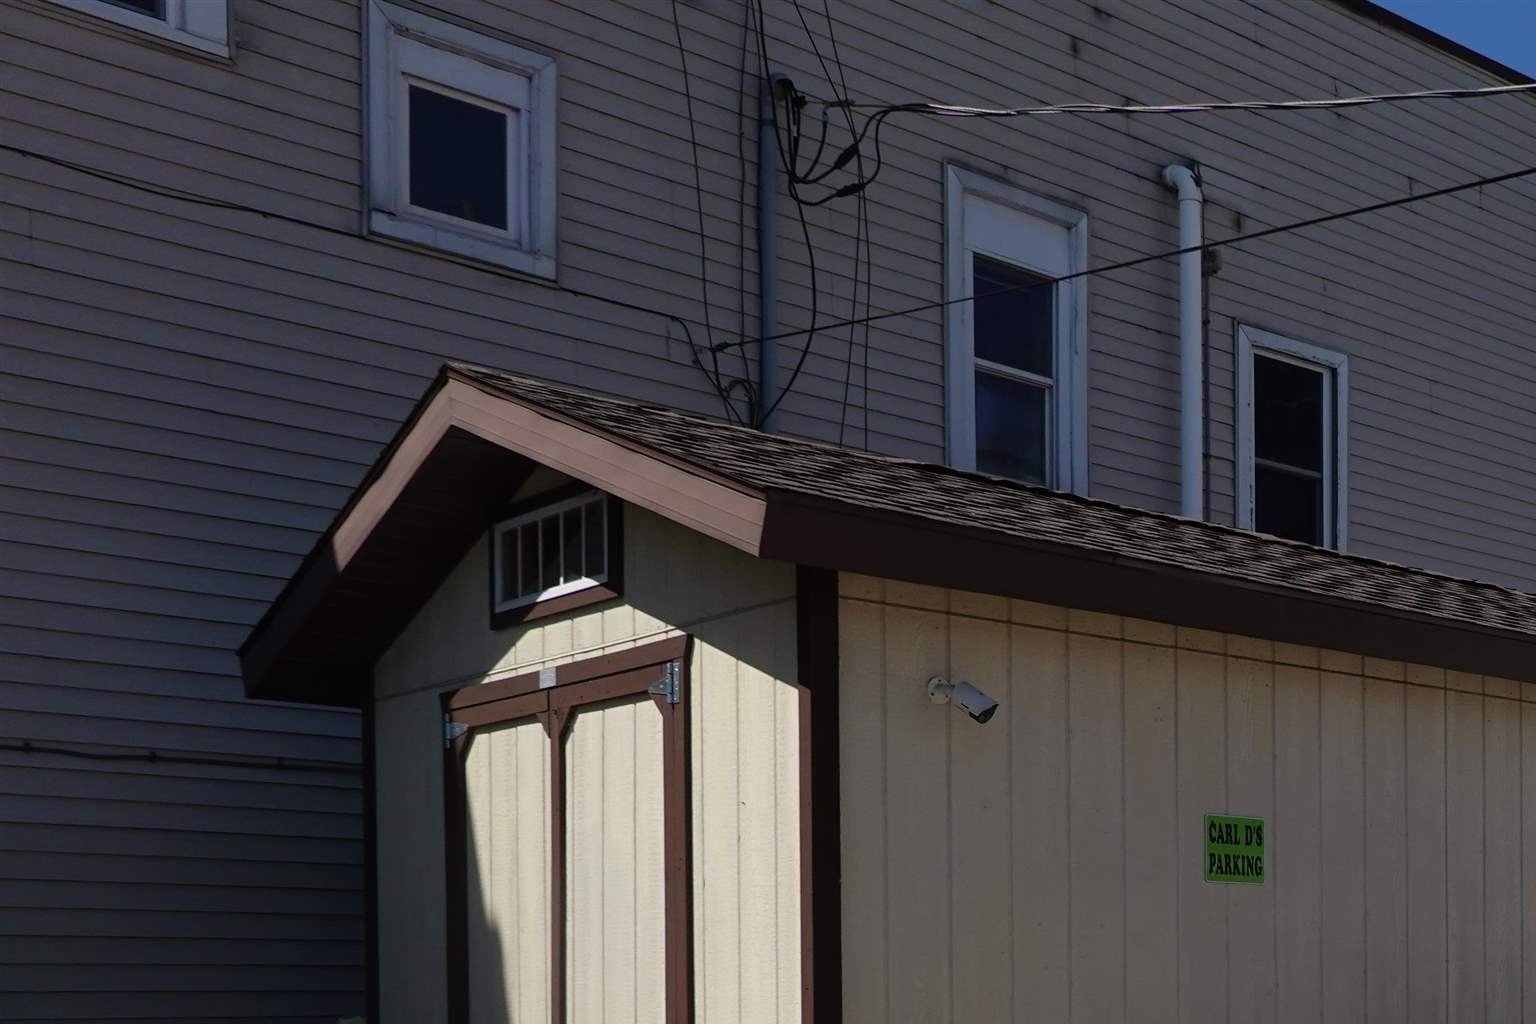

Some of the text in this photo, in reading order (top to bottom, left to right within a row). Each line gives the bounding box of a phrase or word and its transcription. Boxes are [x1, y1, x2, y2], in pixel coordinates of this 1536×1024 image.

[1209, 821, 1263, 847] CARL D'S
[1209, 853, 1263, 876] PARKING
